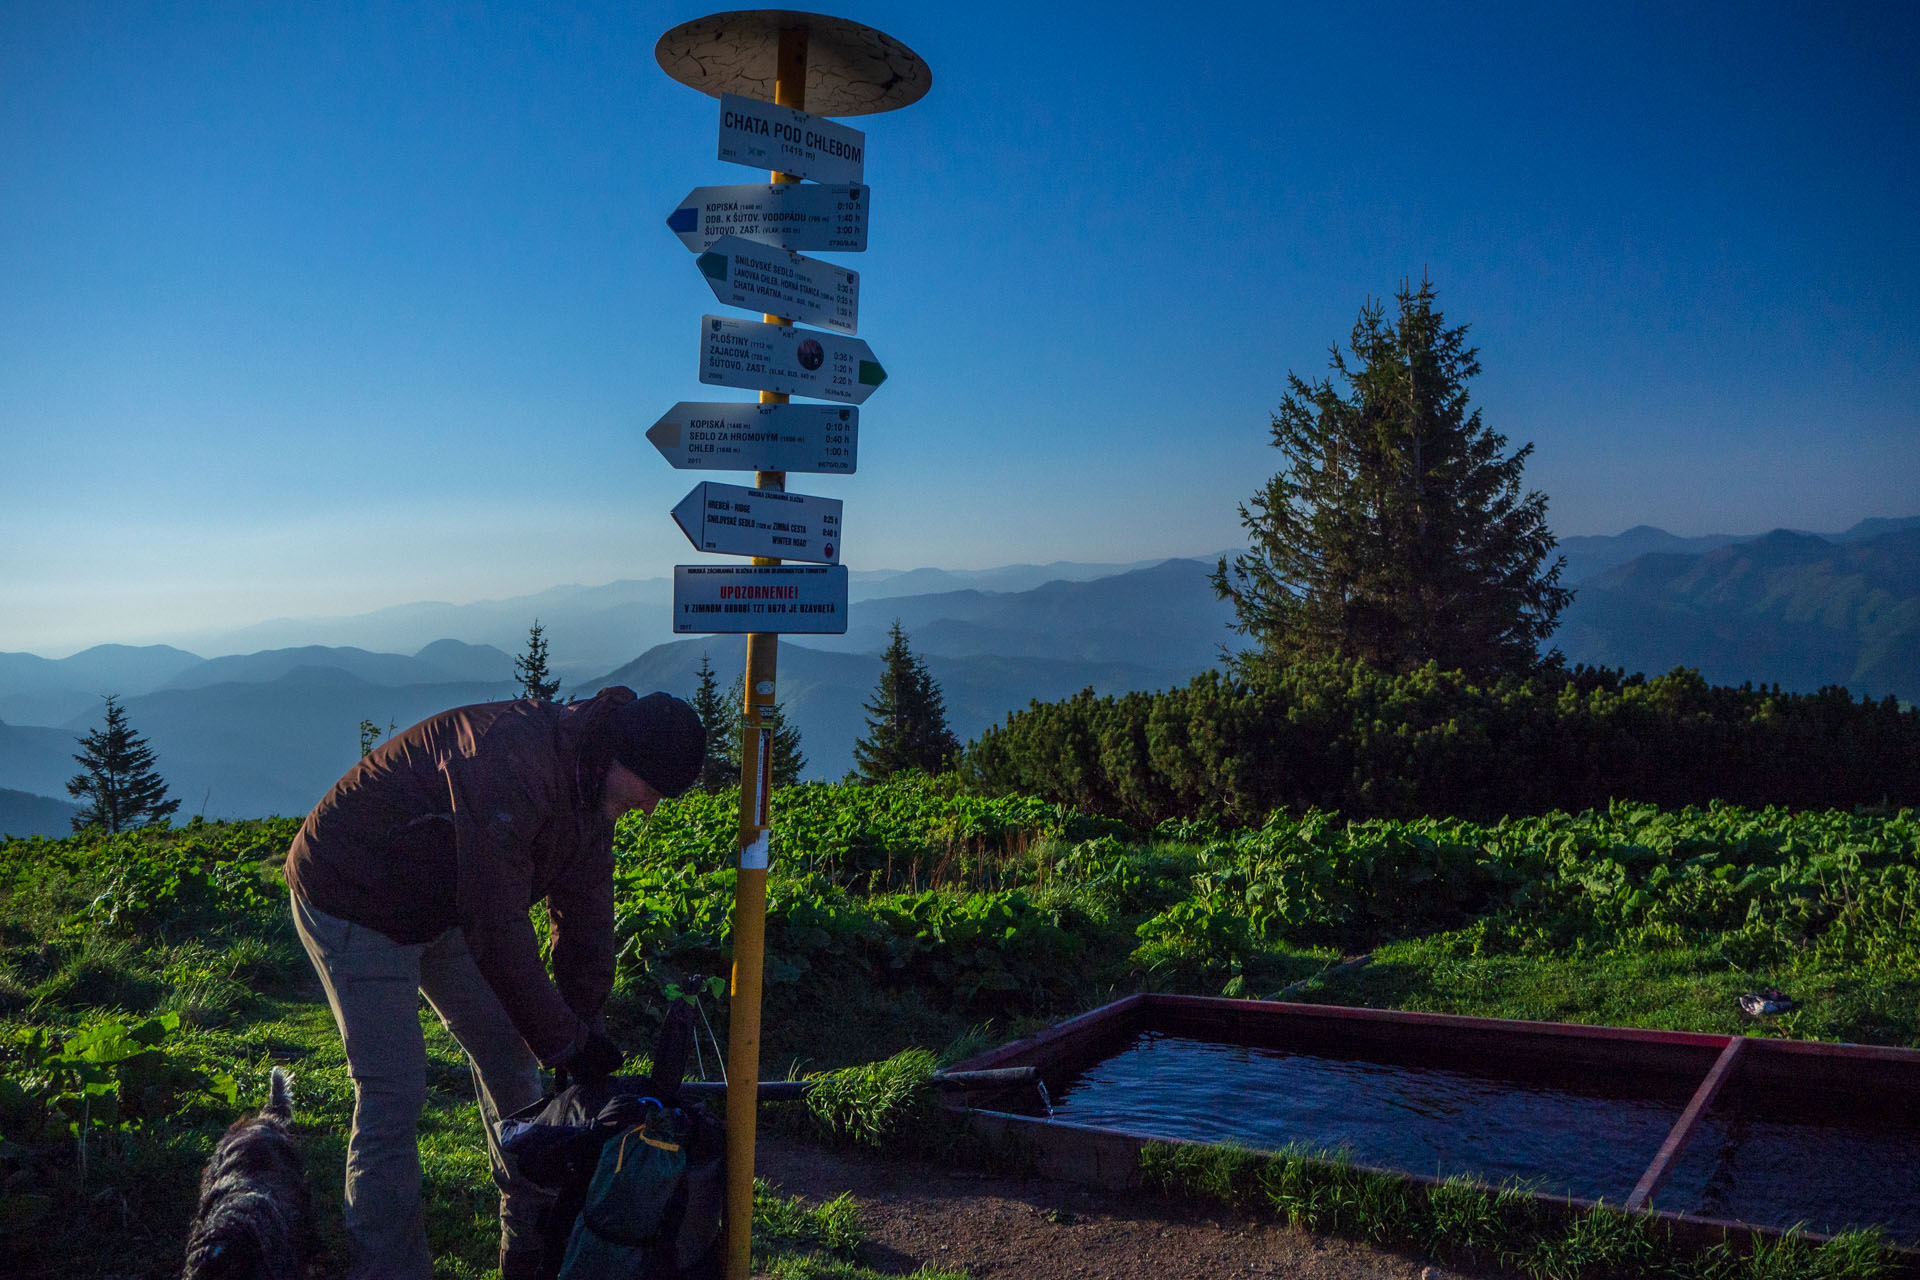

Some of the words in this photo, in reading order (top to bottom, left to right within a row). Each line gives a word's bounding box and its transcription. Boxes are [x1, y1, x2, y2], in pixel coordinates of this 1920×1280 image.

[725, 111, 769, 137] CHATA
[774, 122, 802, 144] POD
[806, 131, 861, 163] CHLEBOM
[781, 143, 803, 157] (1415
[805, 151, 816, 161] m)
[706, 200, 738, 212] KOPISKÁ
[837, 202, 854, 210] 0:10
[856, 202, 860, 210] h
[705, 215, 724, 224] ODB.
[726, 214, 731, 223] K
[762, 211, 806, 222] VODOPÁDU
[837, 214, 853, 222] 1:40
[856, 214, 860, 222] h
[740, 225, 760, 234] ZAST.
[735, 254, 771, 273] SNILOVSKÉ
[773, 264, 794, 278] SEDLO
[734, 267, 759, 281] LANOVKA
[733, 279, 755, 293] CHATA
[757, 285, 782, 299] VRÁTNA
[710, 332, 749, 347] PLOŠTINY
[710, 345, 750, 360] ZAJACOVÁ
[849, 354, 854, 363] h
[746, 362, 767, 374] ZAST.
[834, 364, 847, 374] 1:20
[849, 367, 853, 375] h
[833, 375, 847, 385] 2:20
[848, 377, 853, 386] h
[690, 417, 725, 429] KOPISKÁ
[826, 422, 843, 431] 0:10
[845, 423, 850, 431] h
[689, 431, 716, 441] SEDLO
[718, 432, 728, 441] ZA
[731, 431, 779, 442] HROMOVÝM
[826, 435, 843, 444] 0:40
[845, 435, 850, 443] h
[688, 443, 715, 453] CHLEB
[825, 447, 842, 456] 1:00
[844, 448, 849, 456] h
[707, 514, 737, 526] SNILOVSKÉ
[738, 518, 756, 528] SEDLO
[791, 525, 807, 534] CESTA
[720, 585, 799, 600] UPOZORNENIE!
[684, 603, 690, 613] V
[691, 603, 722, 613] ZIMNOM
[753, 603, 765, 613] TZT
[789, 603, 798, 613] JE
[800, 602, 835, 614] UZAVRETÁ
